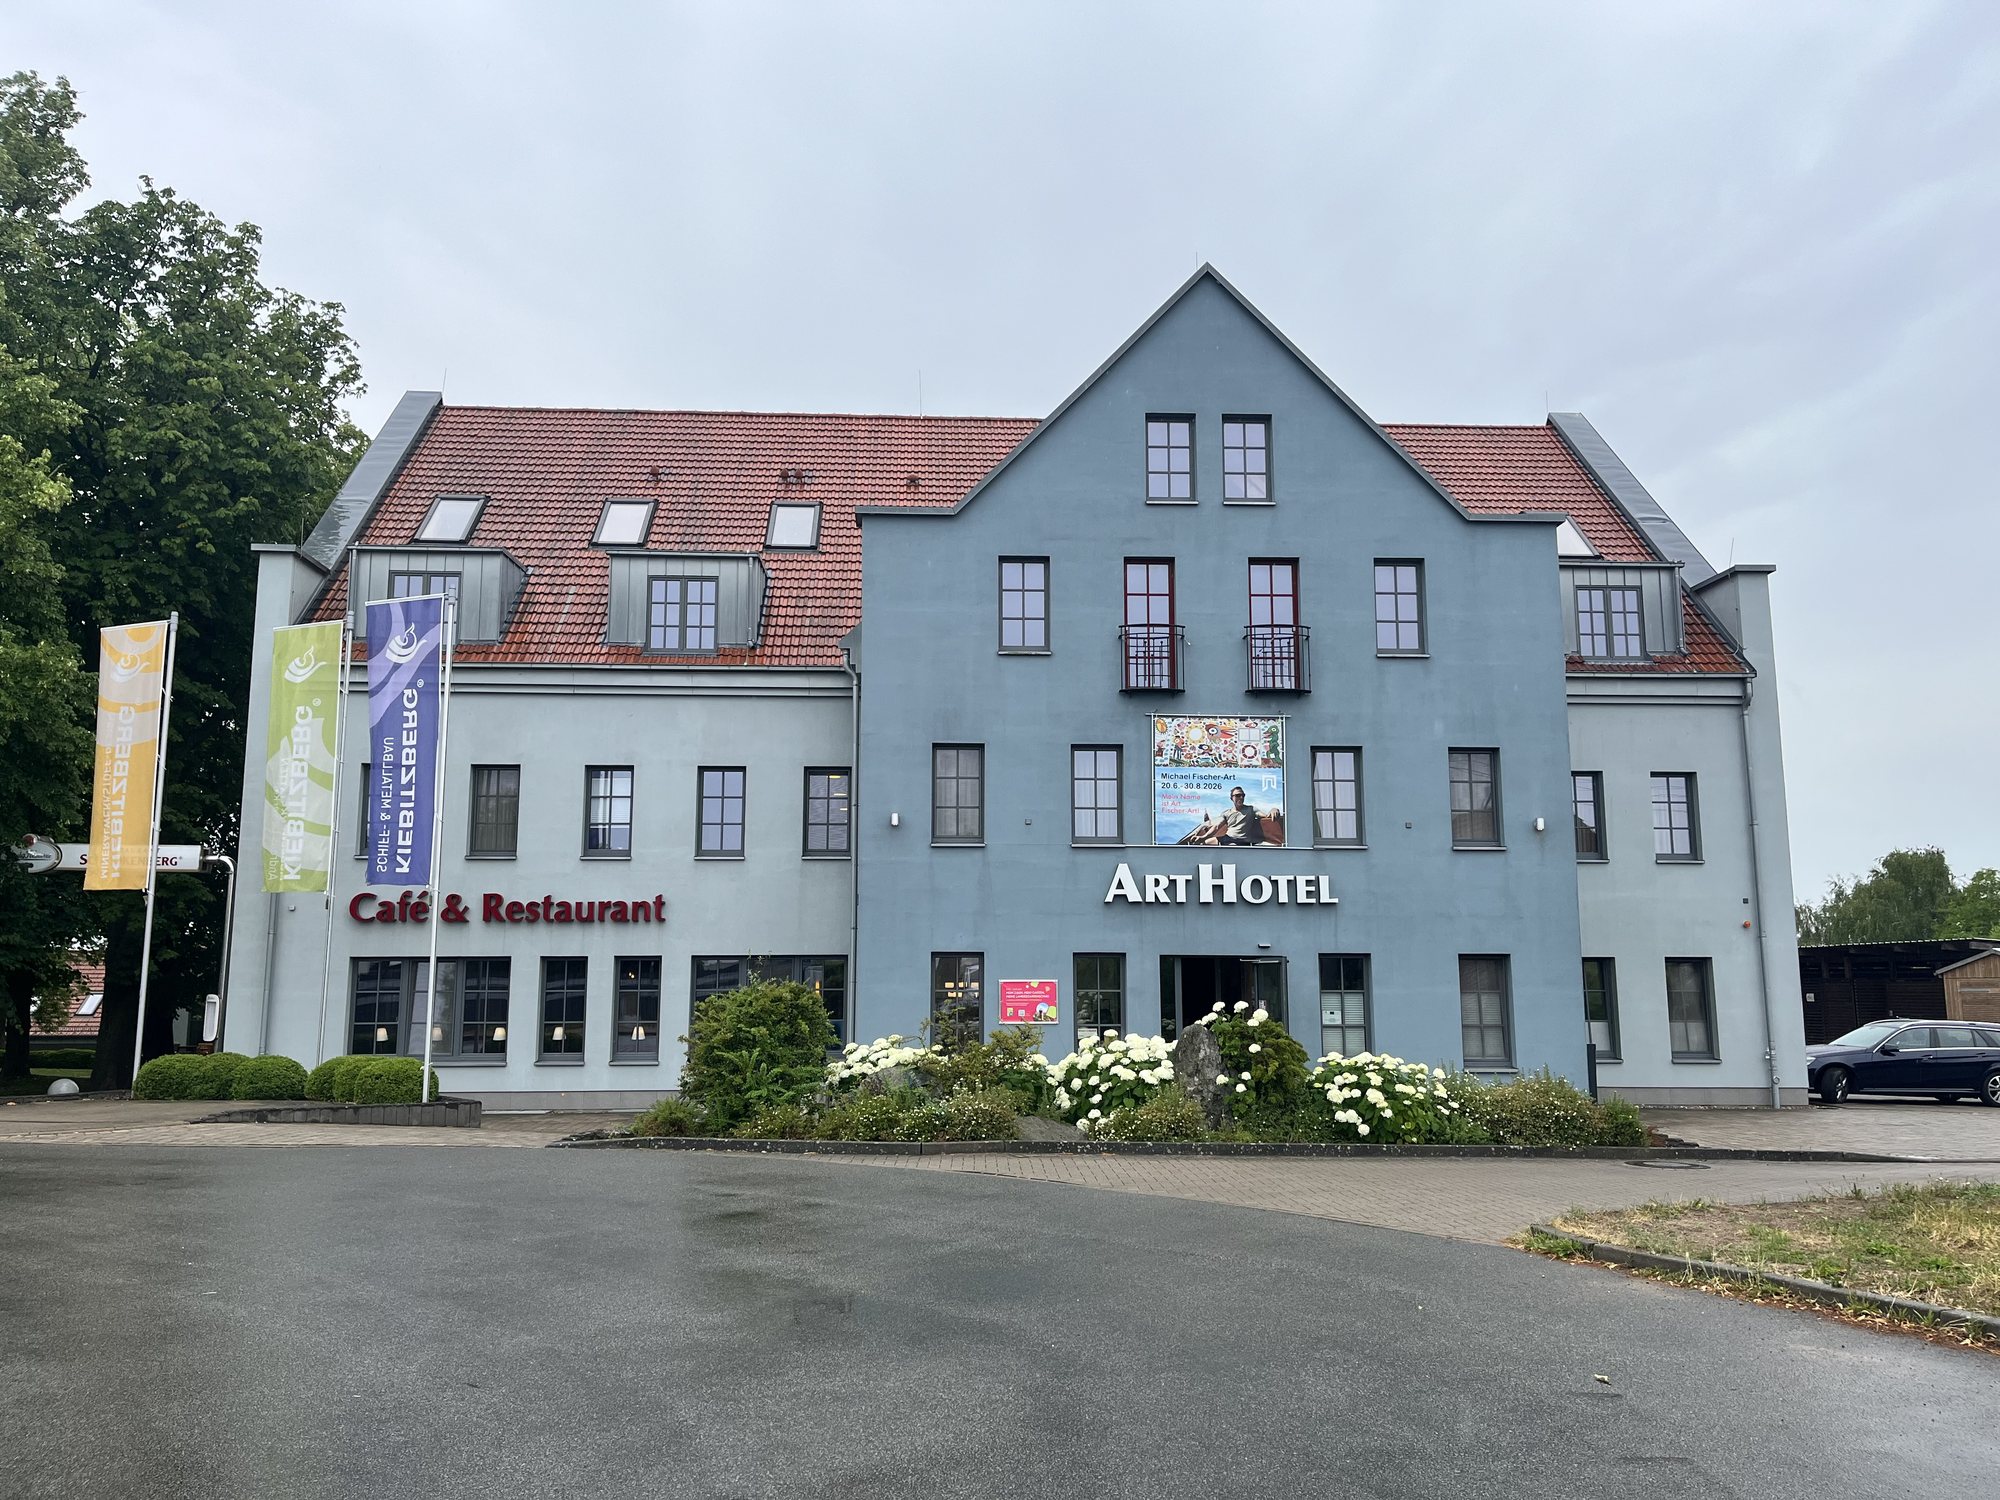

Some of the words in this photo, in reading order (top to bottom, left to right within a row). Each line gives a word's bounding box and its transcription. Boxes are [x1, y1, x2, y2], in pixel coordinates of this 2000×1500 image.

[349, 890, 430, 923] Café
[440, 893, 470, 923] &
[482, 893, 667, 923] Restaurant
